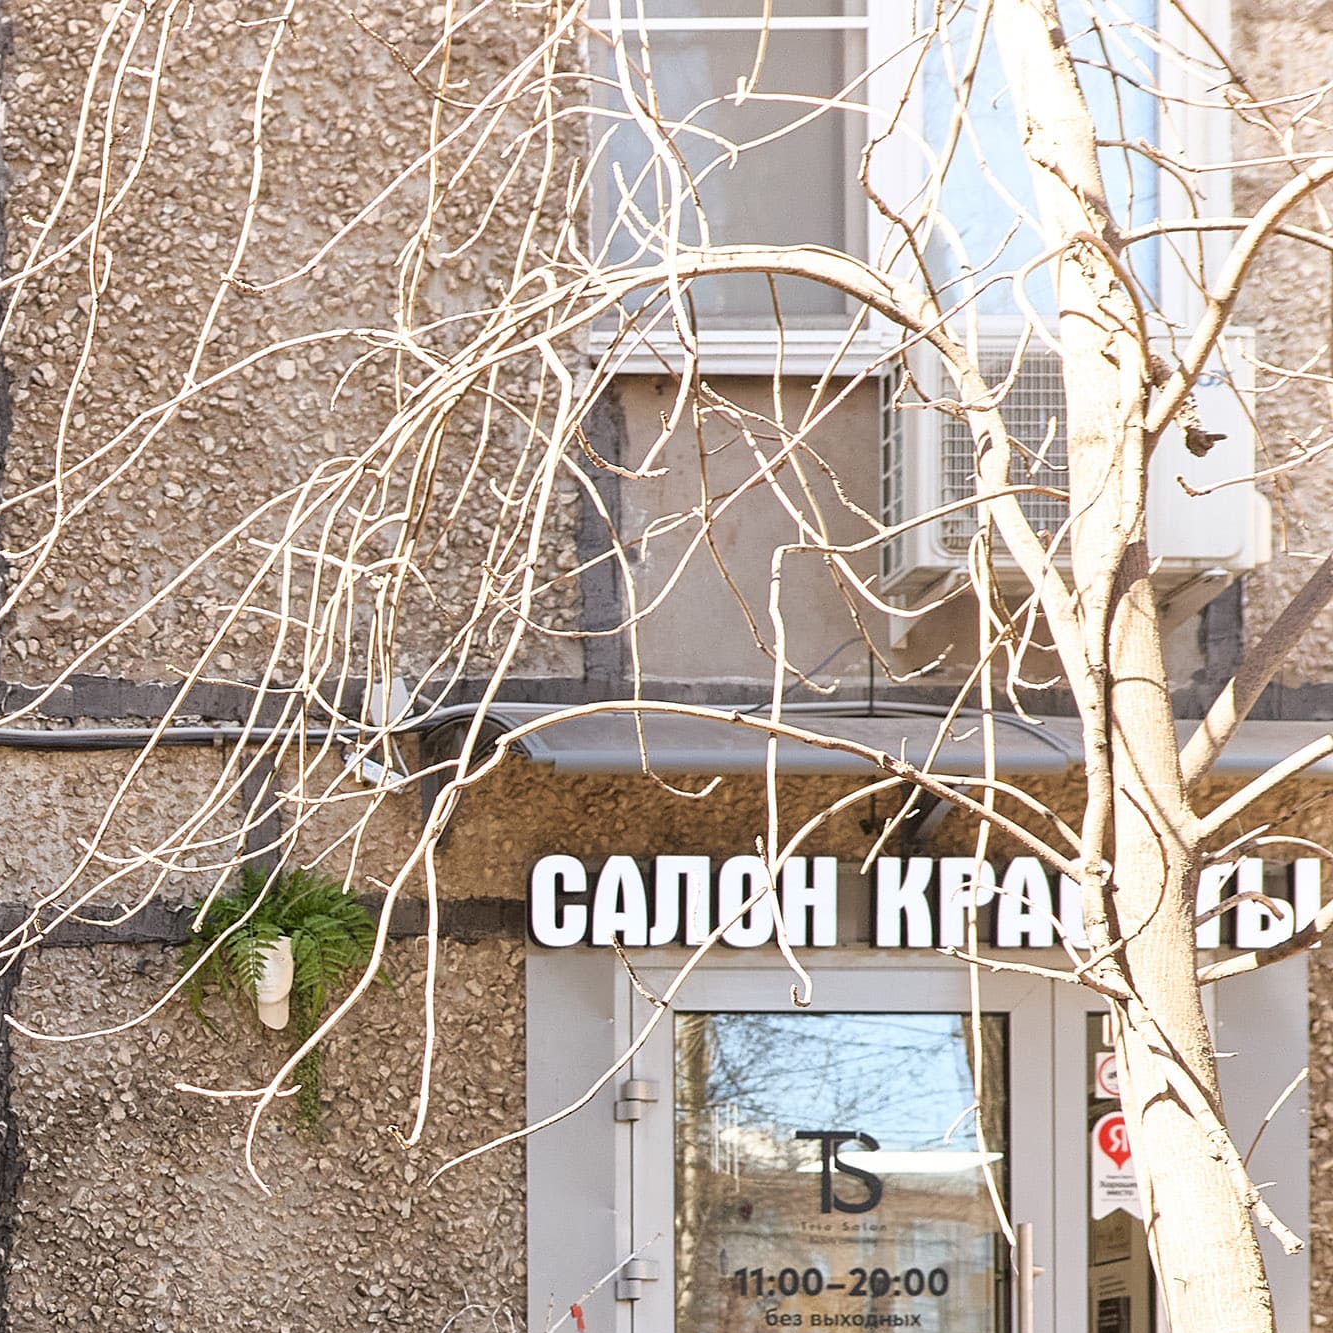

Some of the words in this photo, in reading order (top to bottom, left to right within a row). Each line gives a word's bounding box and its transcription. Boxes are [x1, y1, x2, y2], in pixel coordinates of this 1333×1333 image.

[530, 854, 838, 949] САЛОН
[876, 856, 1322, 950] КРАСТЫ
[795, 1130, 883, 1214] TS
[765, 1308, 803, 1327] без
[810, 1313, 923, 1330] выходных
